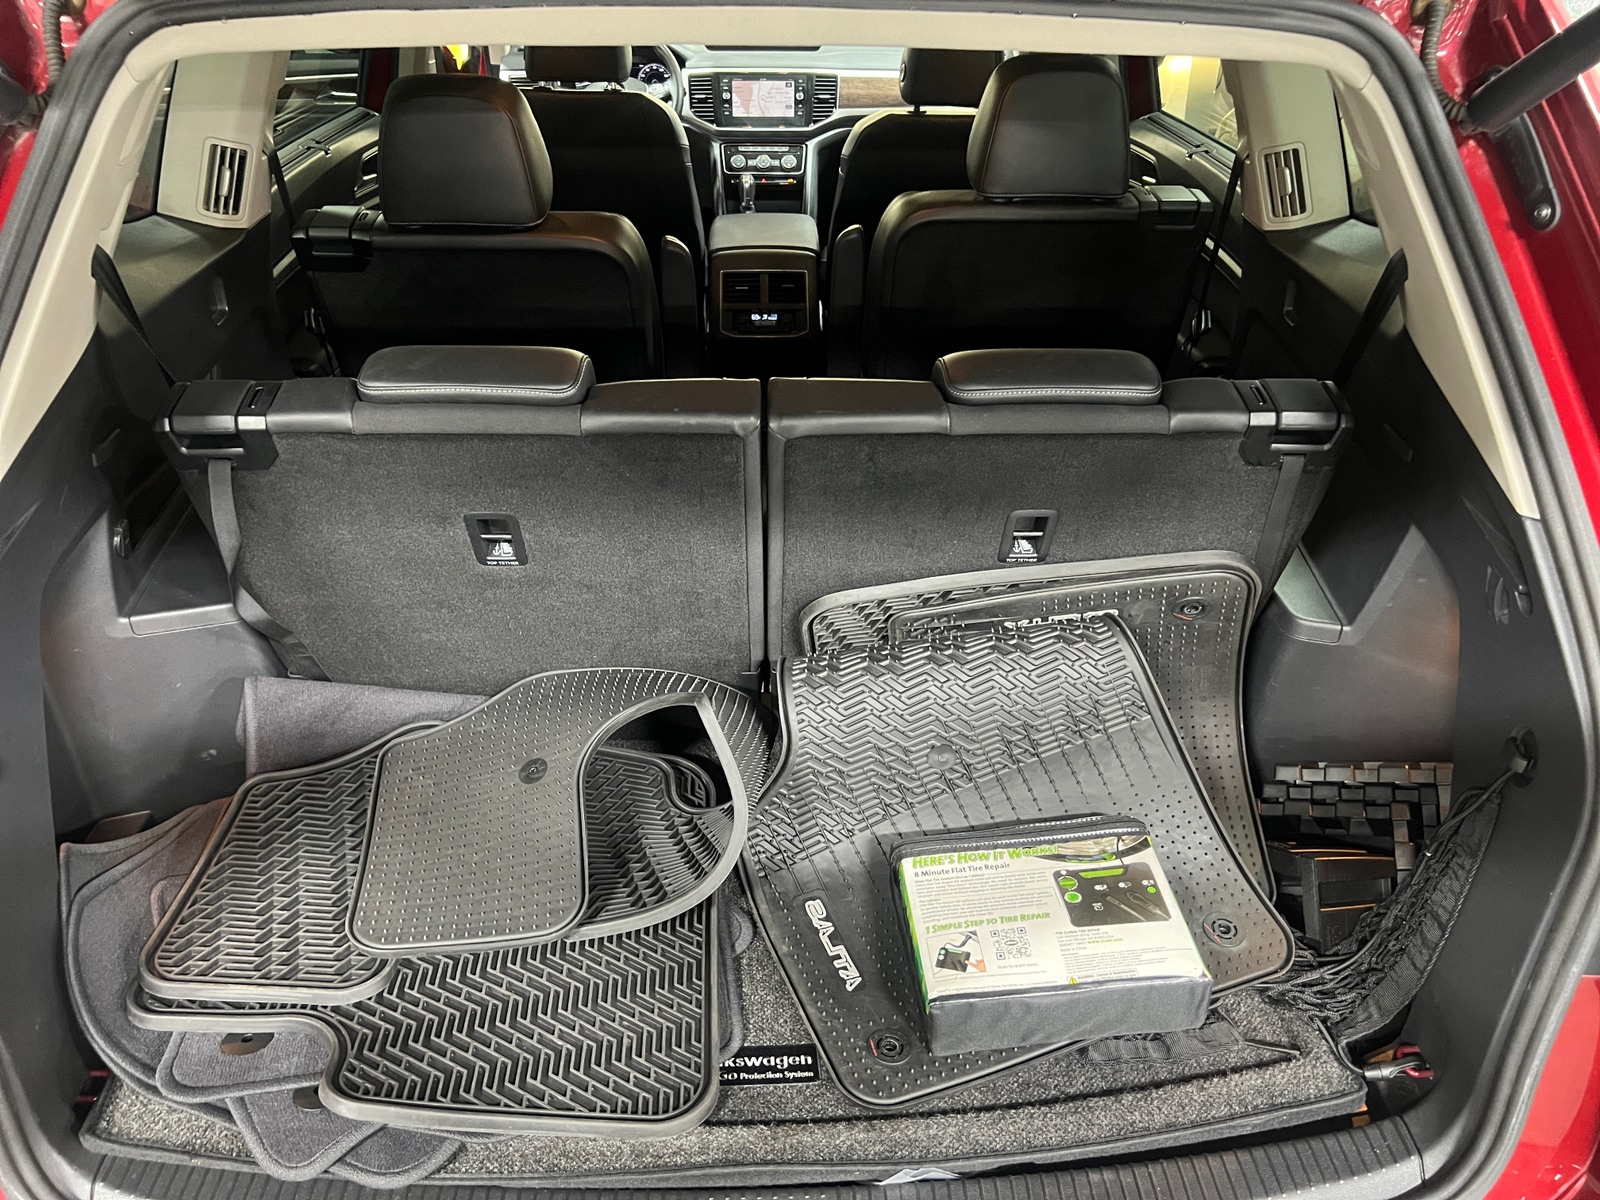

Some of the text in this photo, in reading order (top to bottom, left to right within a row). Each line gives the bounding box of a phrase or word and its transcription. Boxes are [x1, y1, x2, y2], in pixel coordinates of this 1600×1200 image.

[912, 855, 956, 868] HERE'S
[957, 851, 990, 864] HOW
[993, 850, 1005, 861] IT
[921, 869, 950, 877] Minute
[984, 862, 1010, 871] Repair
[932, 921, 963, 934] SIMPLE
[963, 919, 985, 929] STEP
[999, 915, 1019, 924] TIRE
[1020, 912, 1051, 922] REPAIR
[719, 1055, 812, 1069] kswagen
